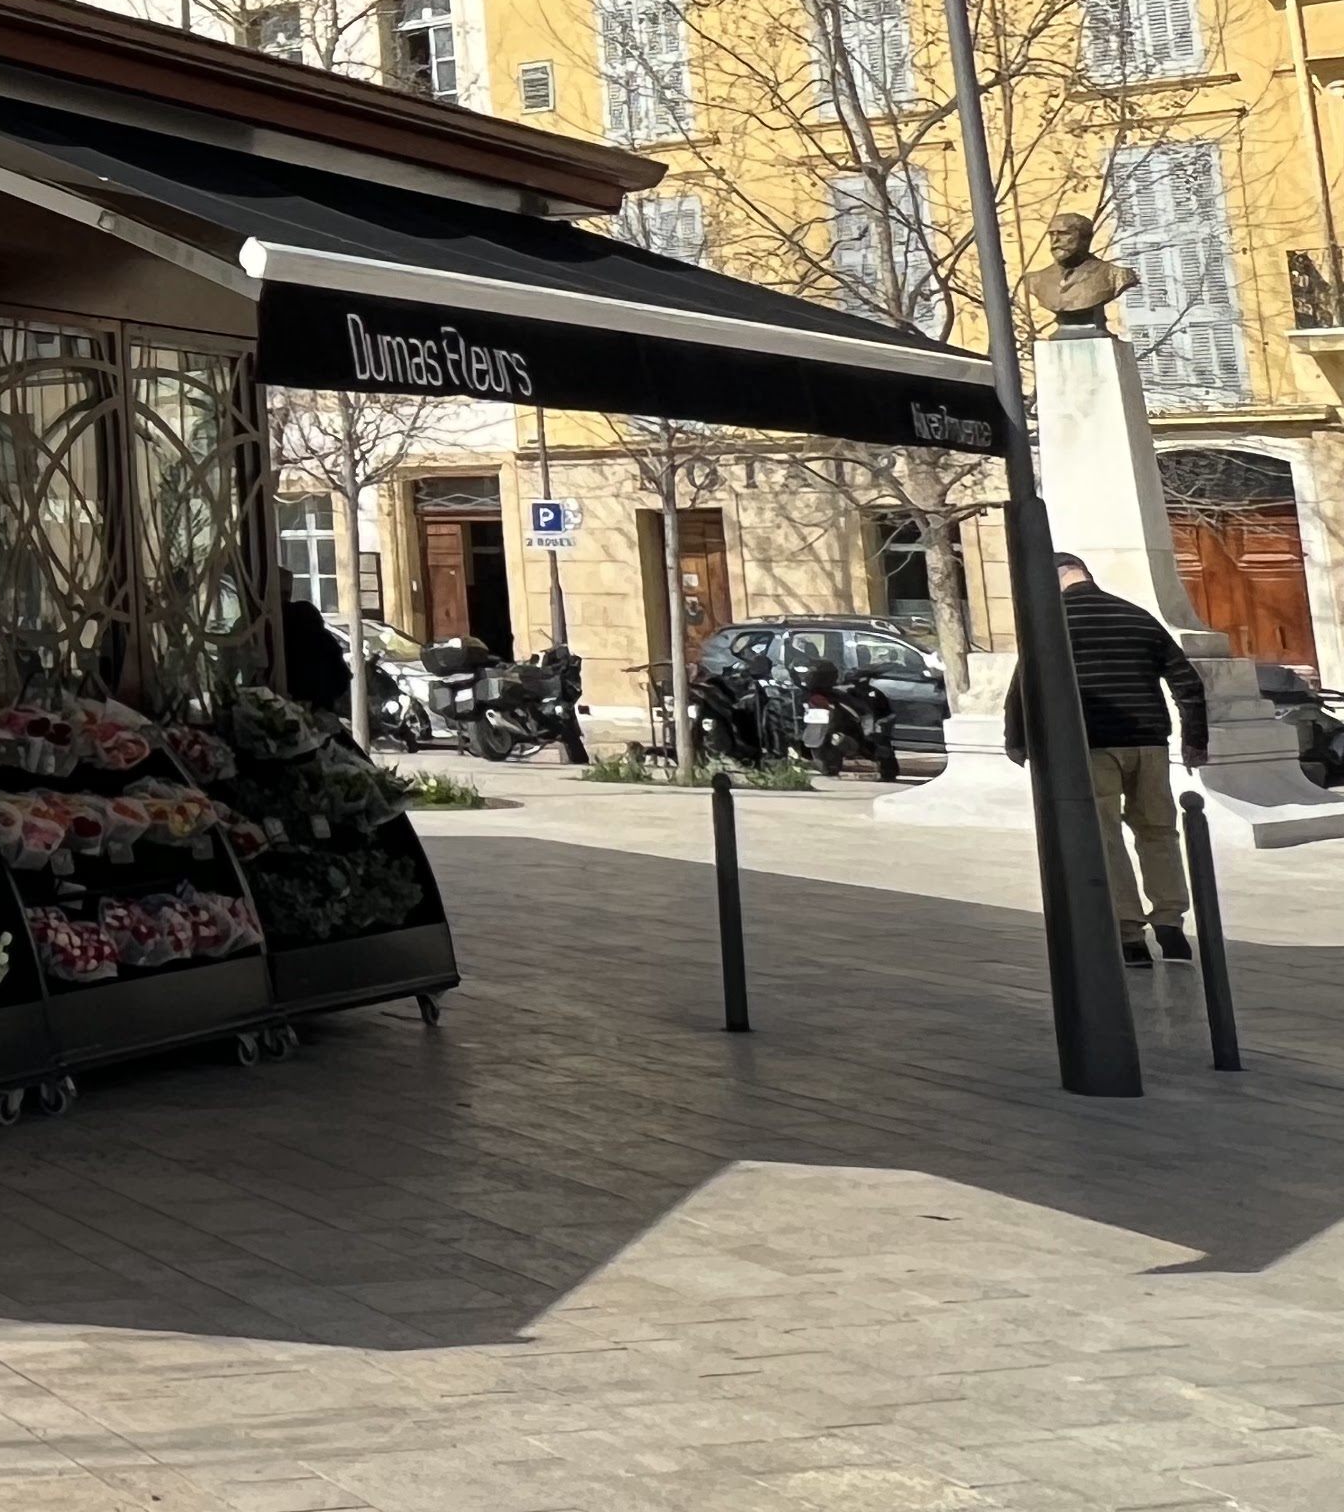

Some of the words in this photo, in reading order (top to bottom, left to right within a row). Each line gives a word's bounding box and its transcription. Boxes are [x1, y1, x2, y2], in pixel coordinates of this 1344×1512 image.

[346, 313, 444, 387] Dumas
[441, 326, 533, 397] Fleurs
[539, 507, 555, 527] P
